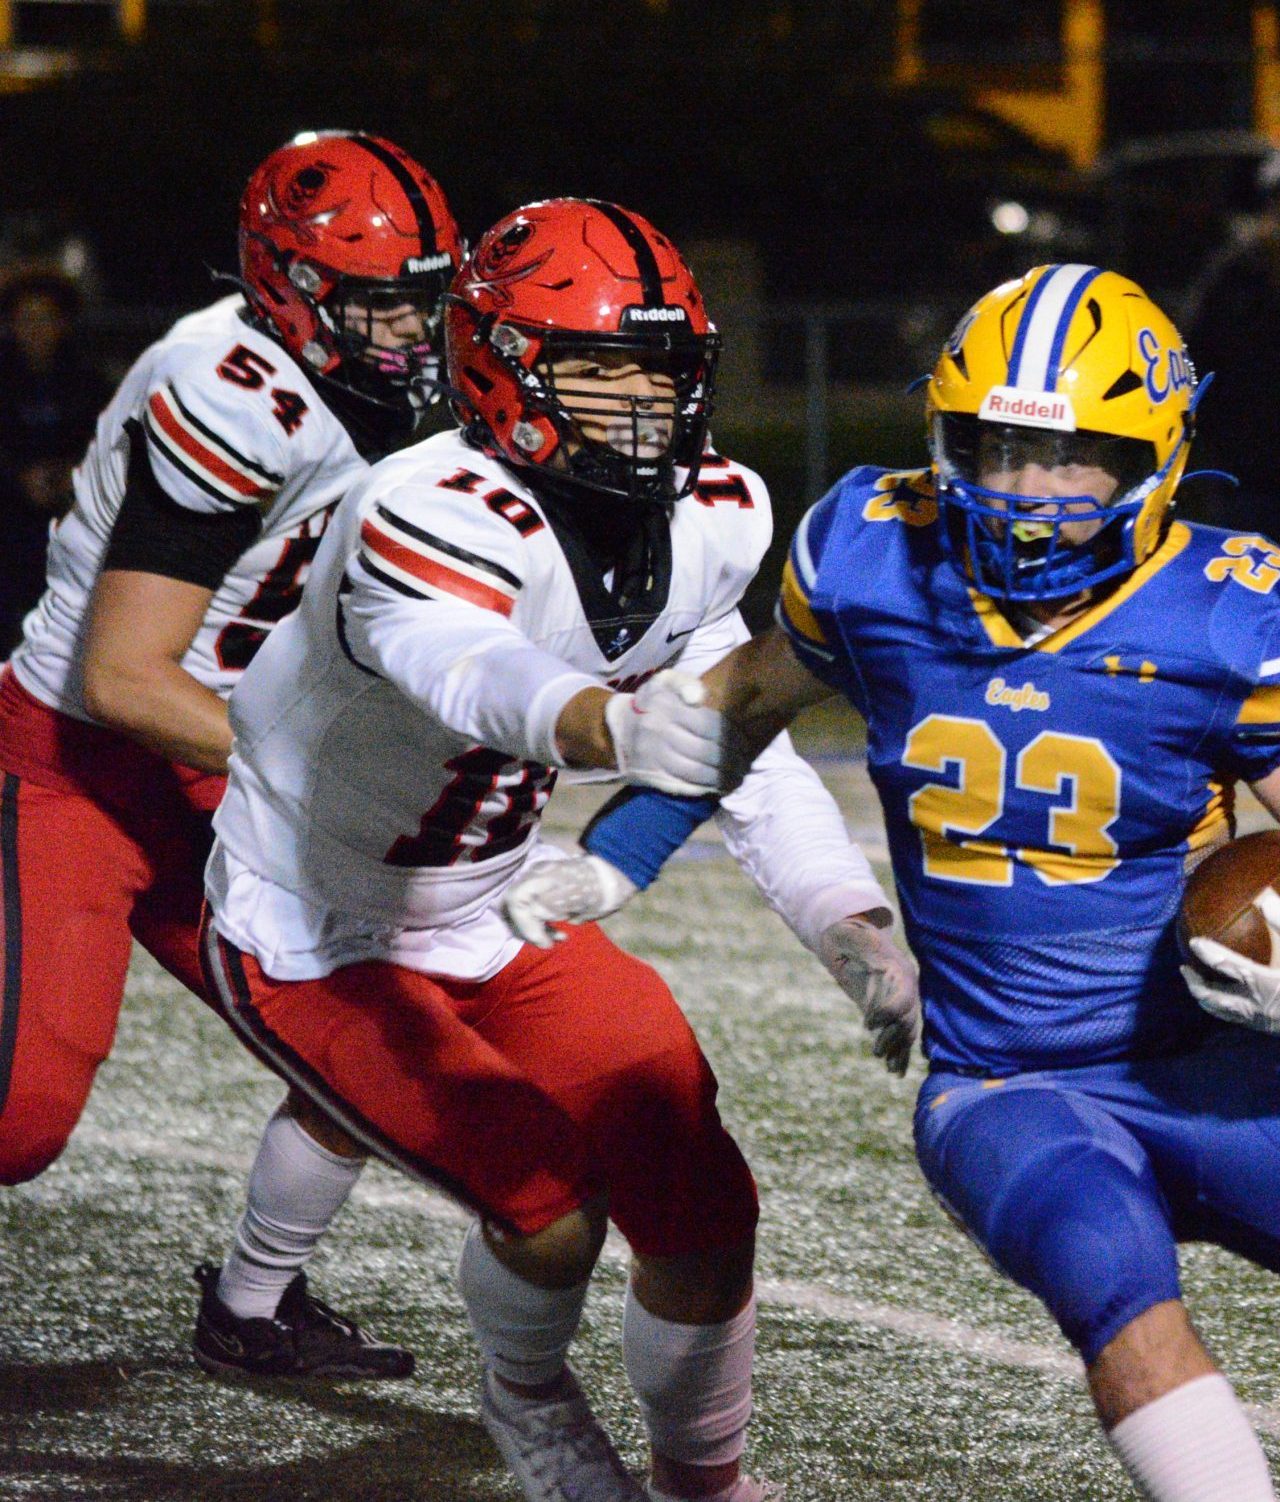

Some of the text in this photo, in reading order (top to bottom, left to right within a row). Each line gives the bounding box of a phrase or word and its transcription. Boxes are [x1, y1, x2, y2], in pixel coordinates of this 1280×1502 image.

[407, 252, 452, 274] Riddell
[630, 308, 686, 322] Riddell
[215, 341, 311, 438] 54
[988, 394, 1065, 420] Riddell
[435, 466, 546, 539] 10
[985, 677, 1051, 712] Eagles
[901, 713, 1123, 887] 23
